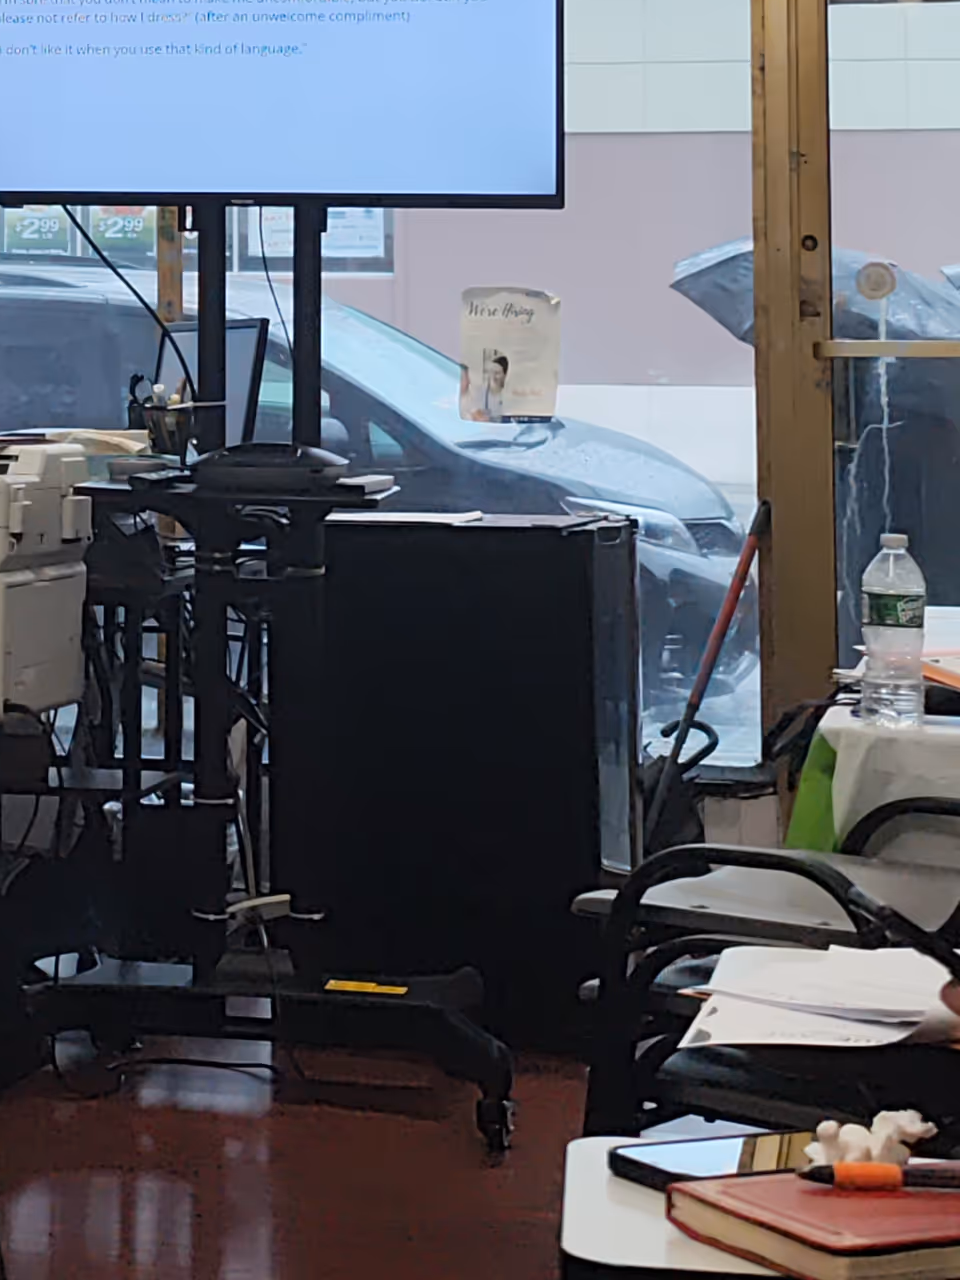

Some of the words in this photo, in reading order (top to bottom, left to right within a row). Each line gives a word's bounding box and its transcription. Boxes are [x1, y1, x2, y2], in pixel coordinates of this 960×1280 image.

[37, 13, 57, 23] not
[61, 12, 90, 23] refer
[94, 13, 107, 23] to
[110, 12, 137, 23] how
[195, 10, 229, 24] (after
[232, 13, 248, 22] an
[252, 10, 325, 22] unwelcome
[6, 44, 37, 55] don't
[41, 44, 62, 55] like
[65, 44, 73, 55] it
[76, 43, 110, 55] when
[114, 45, 136, 58] you
[141, 45, 162, 55] use
[165, 42, 191, 55] that
[195, 42, 221, 54] kind
[225, 42, 238, 54] of
